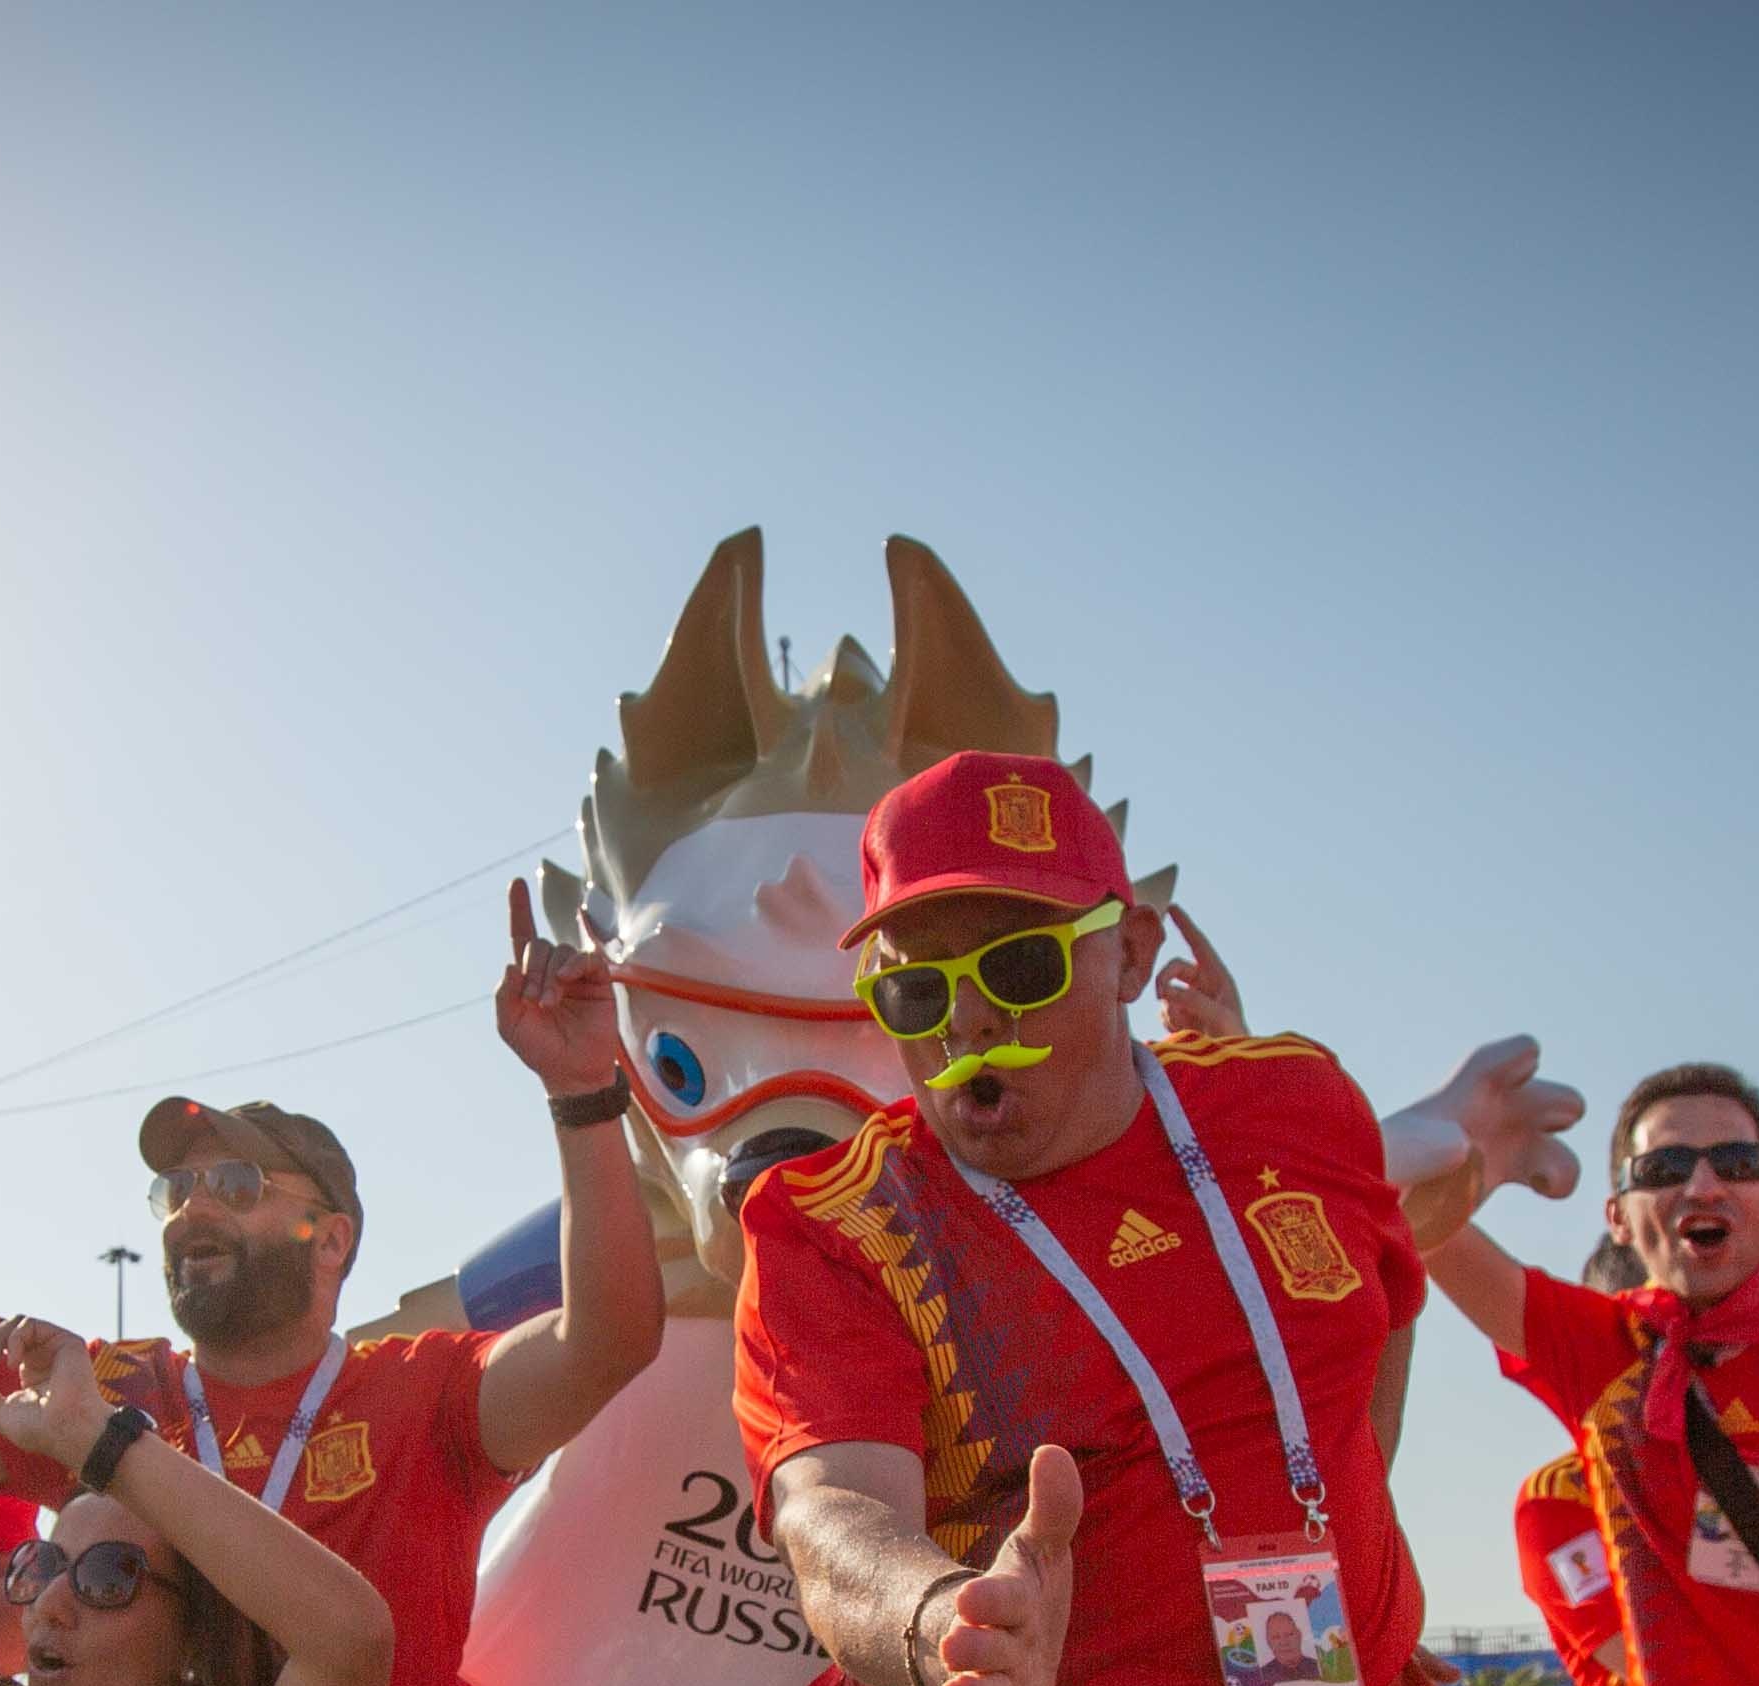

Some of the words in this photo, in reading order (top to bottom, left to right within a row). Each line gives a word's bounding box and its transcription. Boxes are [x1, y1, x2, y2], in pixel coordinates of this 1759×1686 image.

[1107, 1231, 1183, 1269] adidas
[654, 1539, 711, 1580] FIFA
[638, 1569, 831, 1659] RUSSI
